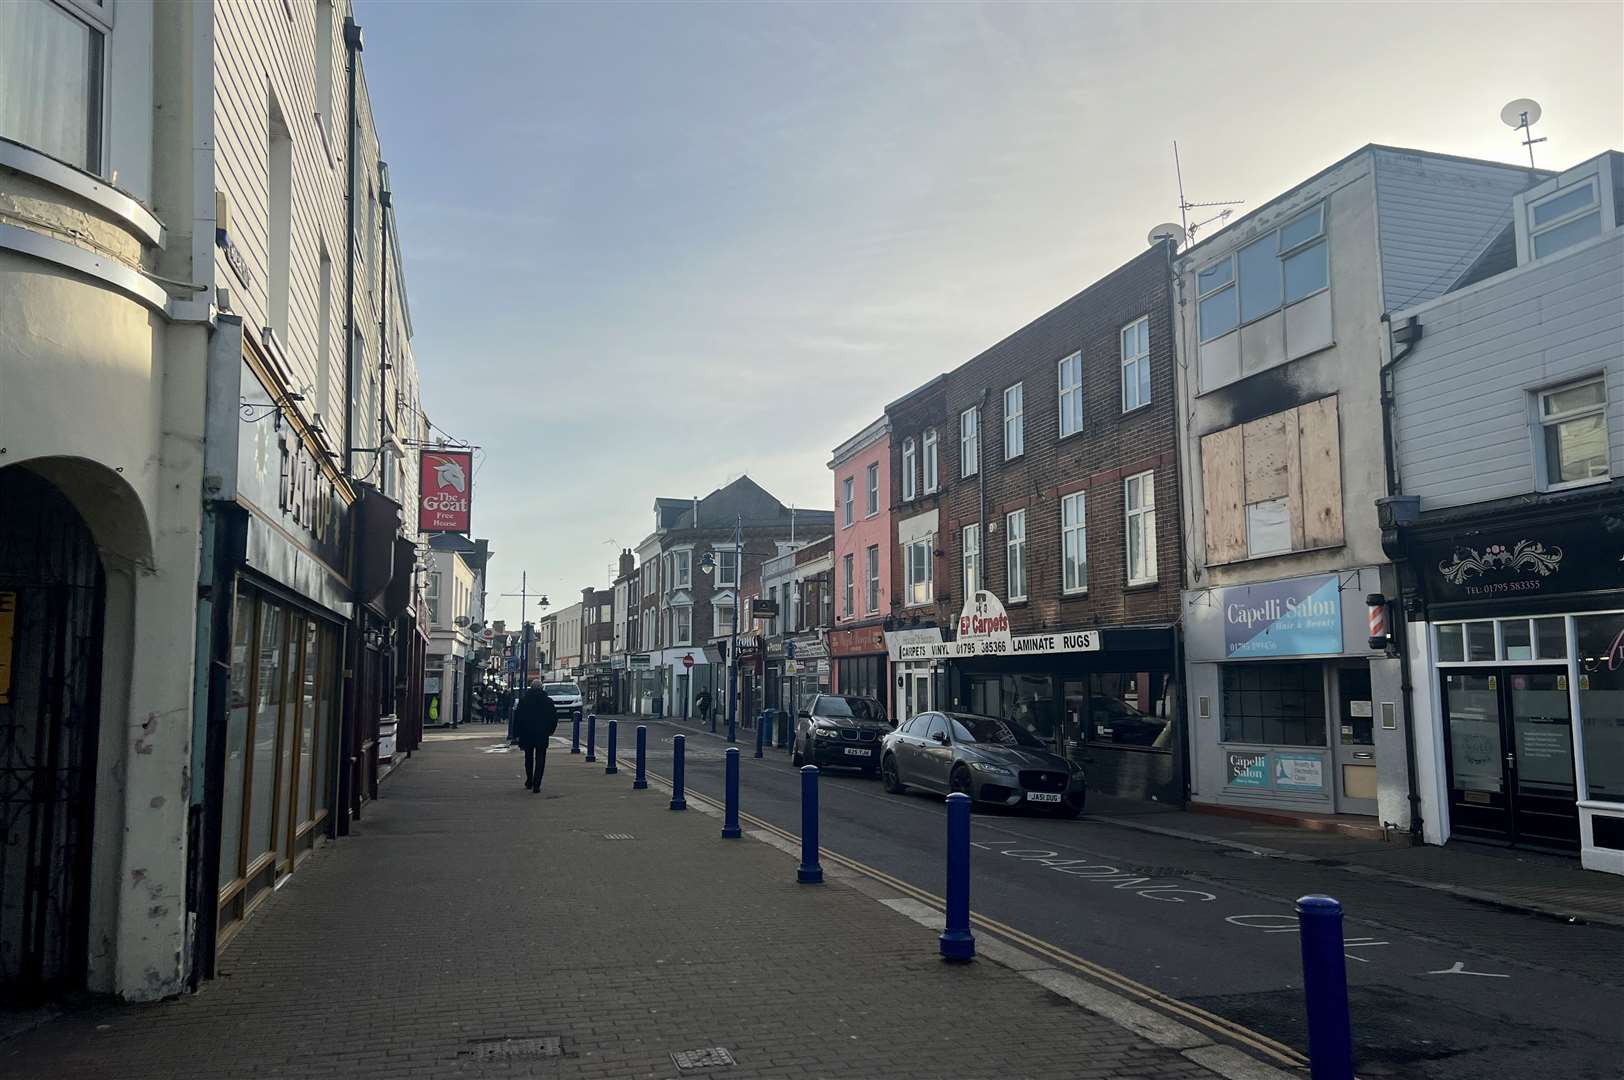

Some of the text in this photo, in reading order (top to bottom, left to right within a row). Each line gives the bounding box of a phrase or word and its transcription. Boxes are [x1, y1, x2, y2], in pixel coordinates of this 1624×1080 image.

[423, 496, 469, 512] Goat
[438, 492, 458, 501] The
[436, 512, 455, 520] Free
[1484, 583, 1508, 593] 01795
[1509, 580, 1541, 591] 583355
[1227, 595, 1336, 629] Capelli Salon
[960, 613, 1008, 638] EP Carpets
[902, 645, 927, 657] CARPETS
[931, 643, 950, 656] VINYL
[956, 642, 976, 655] 01795
[1012, 637, 1055, 652] LAMINATE
[1063, 634, 1090, 649] RUGS
[1229, 754, 1265, 769] Capelli
[1233, 767, 1263, 779] Salon
[969, 841, 1217, 903] LOADING
